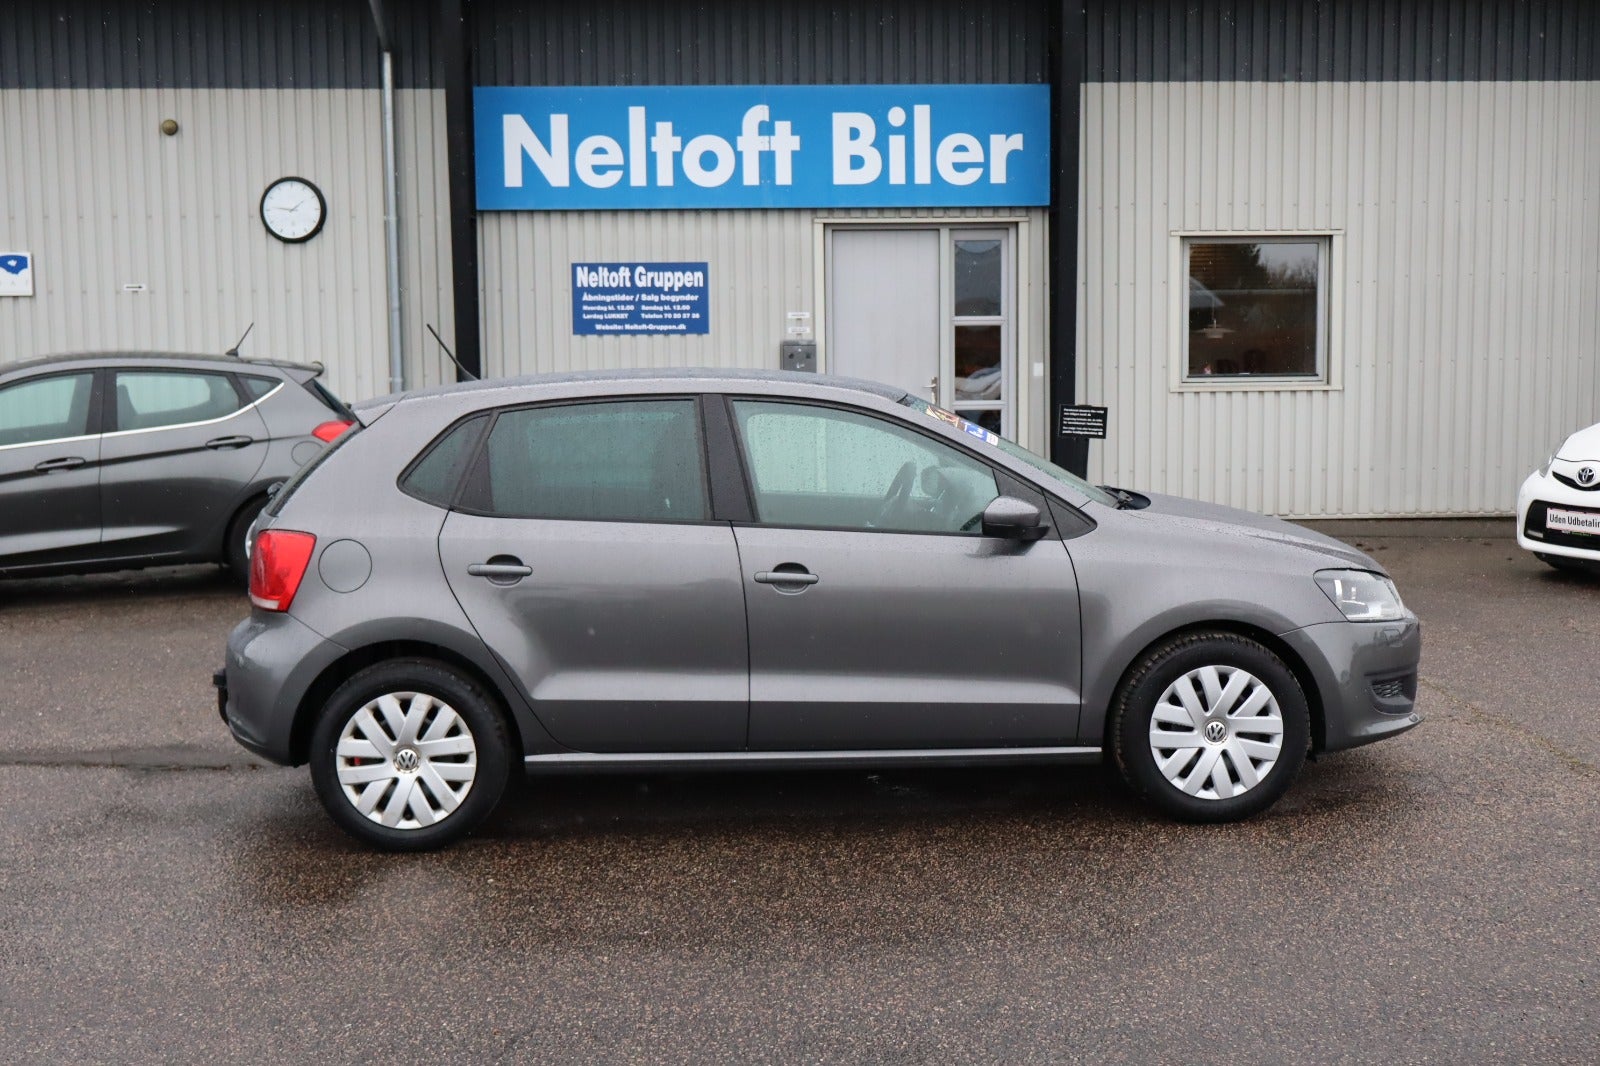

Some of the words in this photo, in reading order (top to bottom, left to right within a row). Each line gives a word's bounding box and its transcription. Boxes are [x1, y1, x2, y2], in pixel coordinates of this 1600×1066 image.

[502, 104, 801, 188] Neltoft
[832, 104, 1024, 186] Biler
[576, 265, 631, 288] Neltoft
[634, 265, 704, 292] Gruppen
[582, 292, 634, 302] Åbningstider
[641, 293, 659, 303] Salg
[660, 293, 699, 303] begynder
[1549, 513, 1565, 523] Uden
